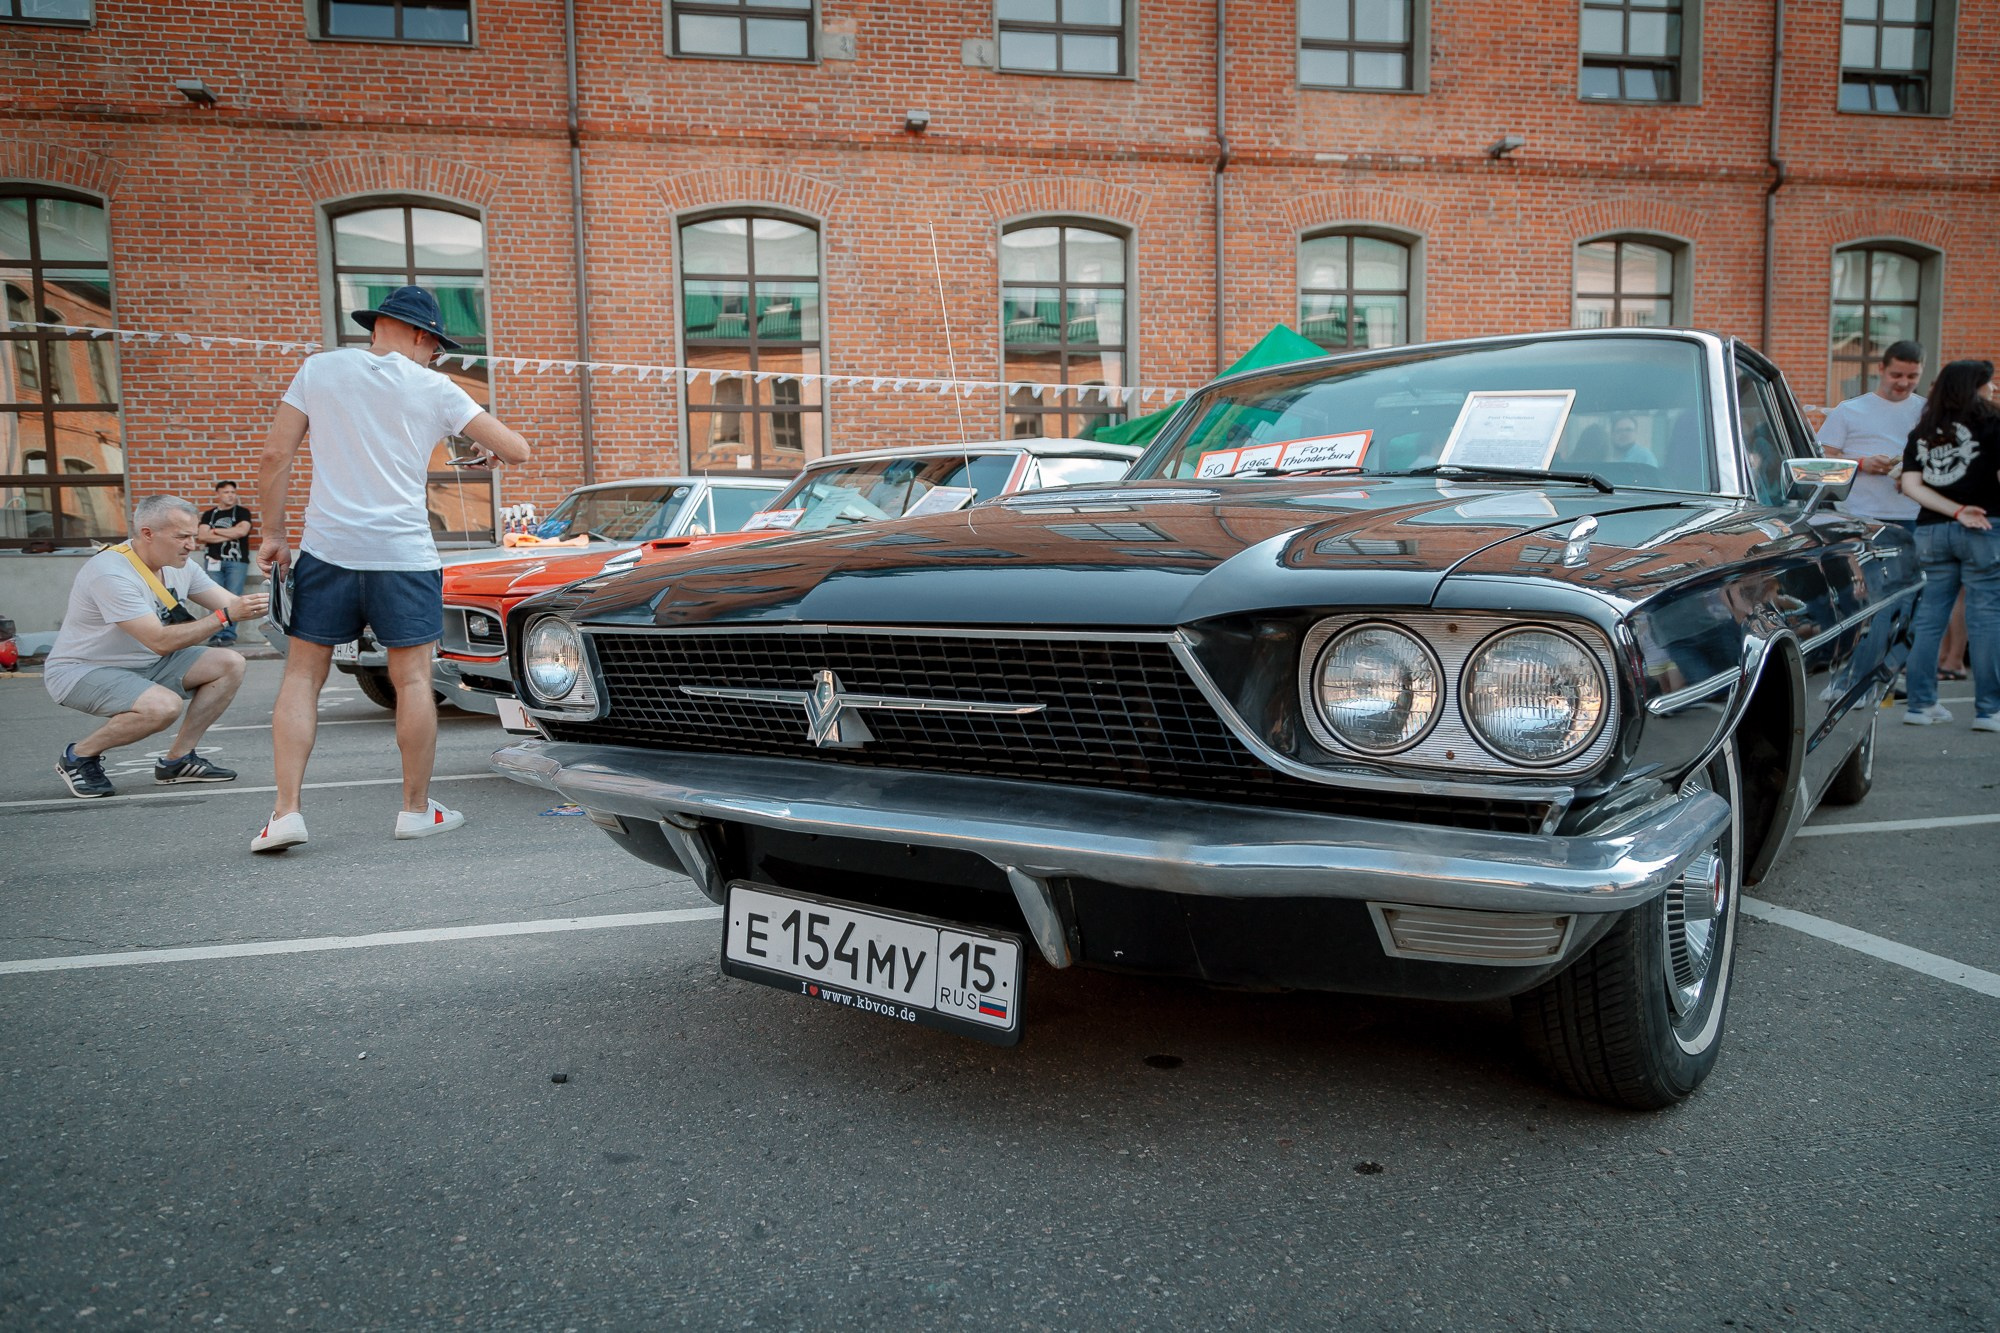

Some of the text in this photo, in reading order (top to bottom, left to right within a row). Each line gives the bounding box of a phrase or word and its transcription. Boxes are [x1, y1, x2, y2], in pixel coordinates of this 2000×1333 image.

[1300, 443, 1338, 455] Ford
[1239, 457, 1272, 472] 1966
[1282, 450, 1356, 467] Thunderbird
[1202, 463, 1225, 478] 50
[949, 941, 997, 993] 15
[801, 981, 916, 1022] I www.kbvos.de
[940, 986, 978, 1010] RUS
